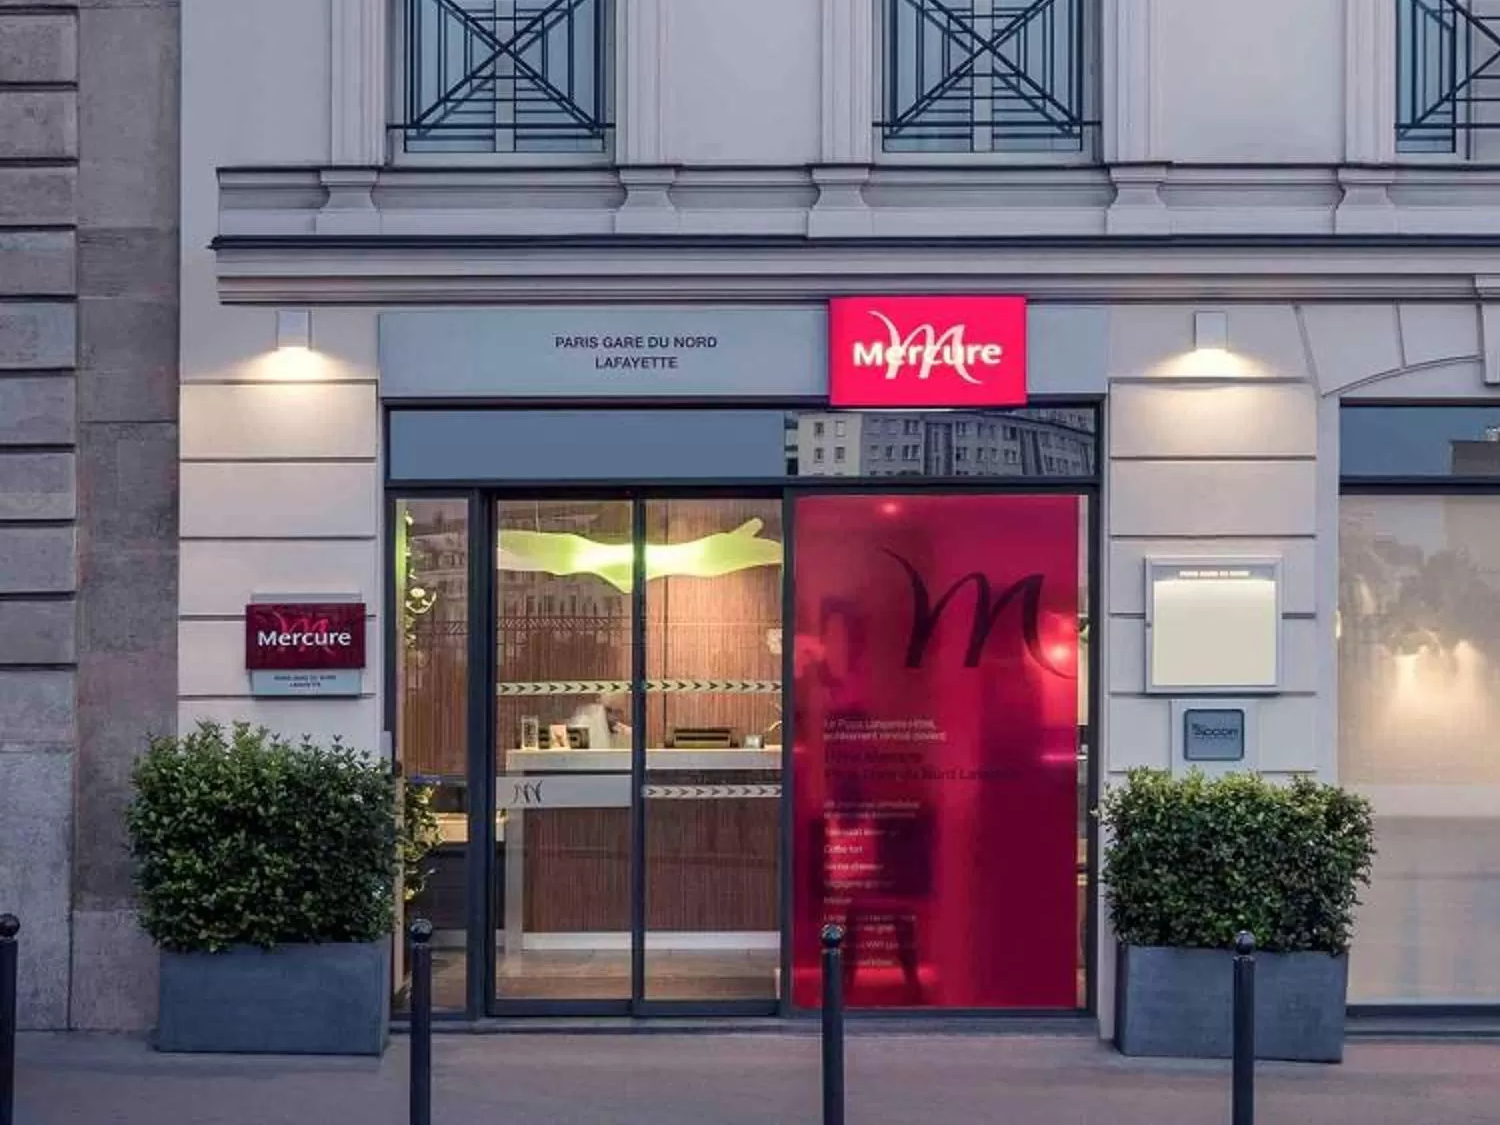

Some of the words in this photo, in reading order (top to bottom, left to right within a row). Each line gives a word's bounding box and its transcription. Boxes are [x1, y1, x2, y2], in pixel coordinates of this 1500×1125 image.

[555, 336, 598, 348] PARIS
[602, 336, 643, 348] GARE
[647, 336, 669, 348] DU
[673, 336, 717, 348] NORD
[852, 341, 1003, 366] Mercure
[595, 356, 678, 369] LAFAYETTE
[257, 630, 352, 646] Mercure
